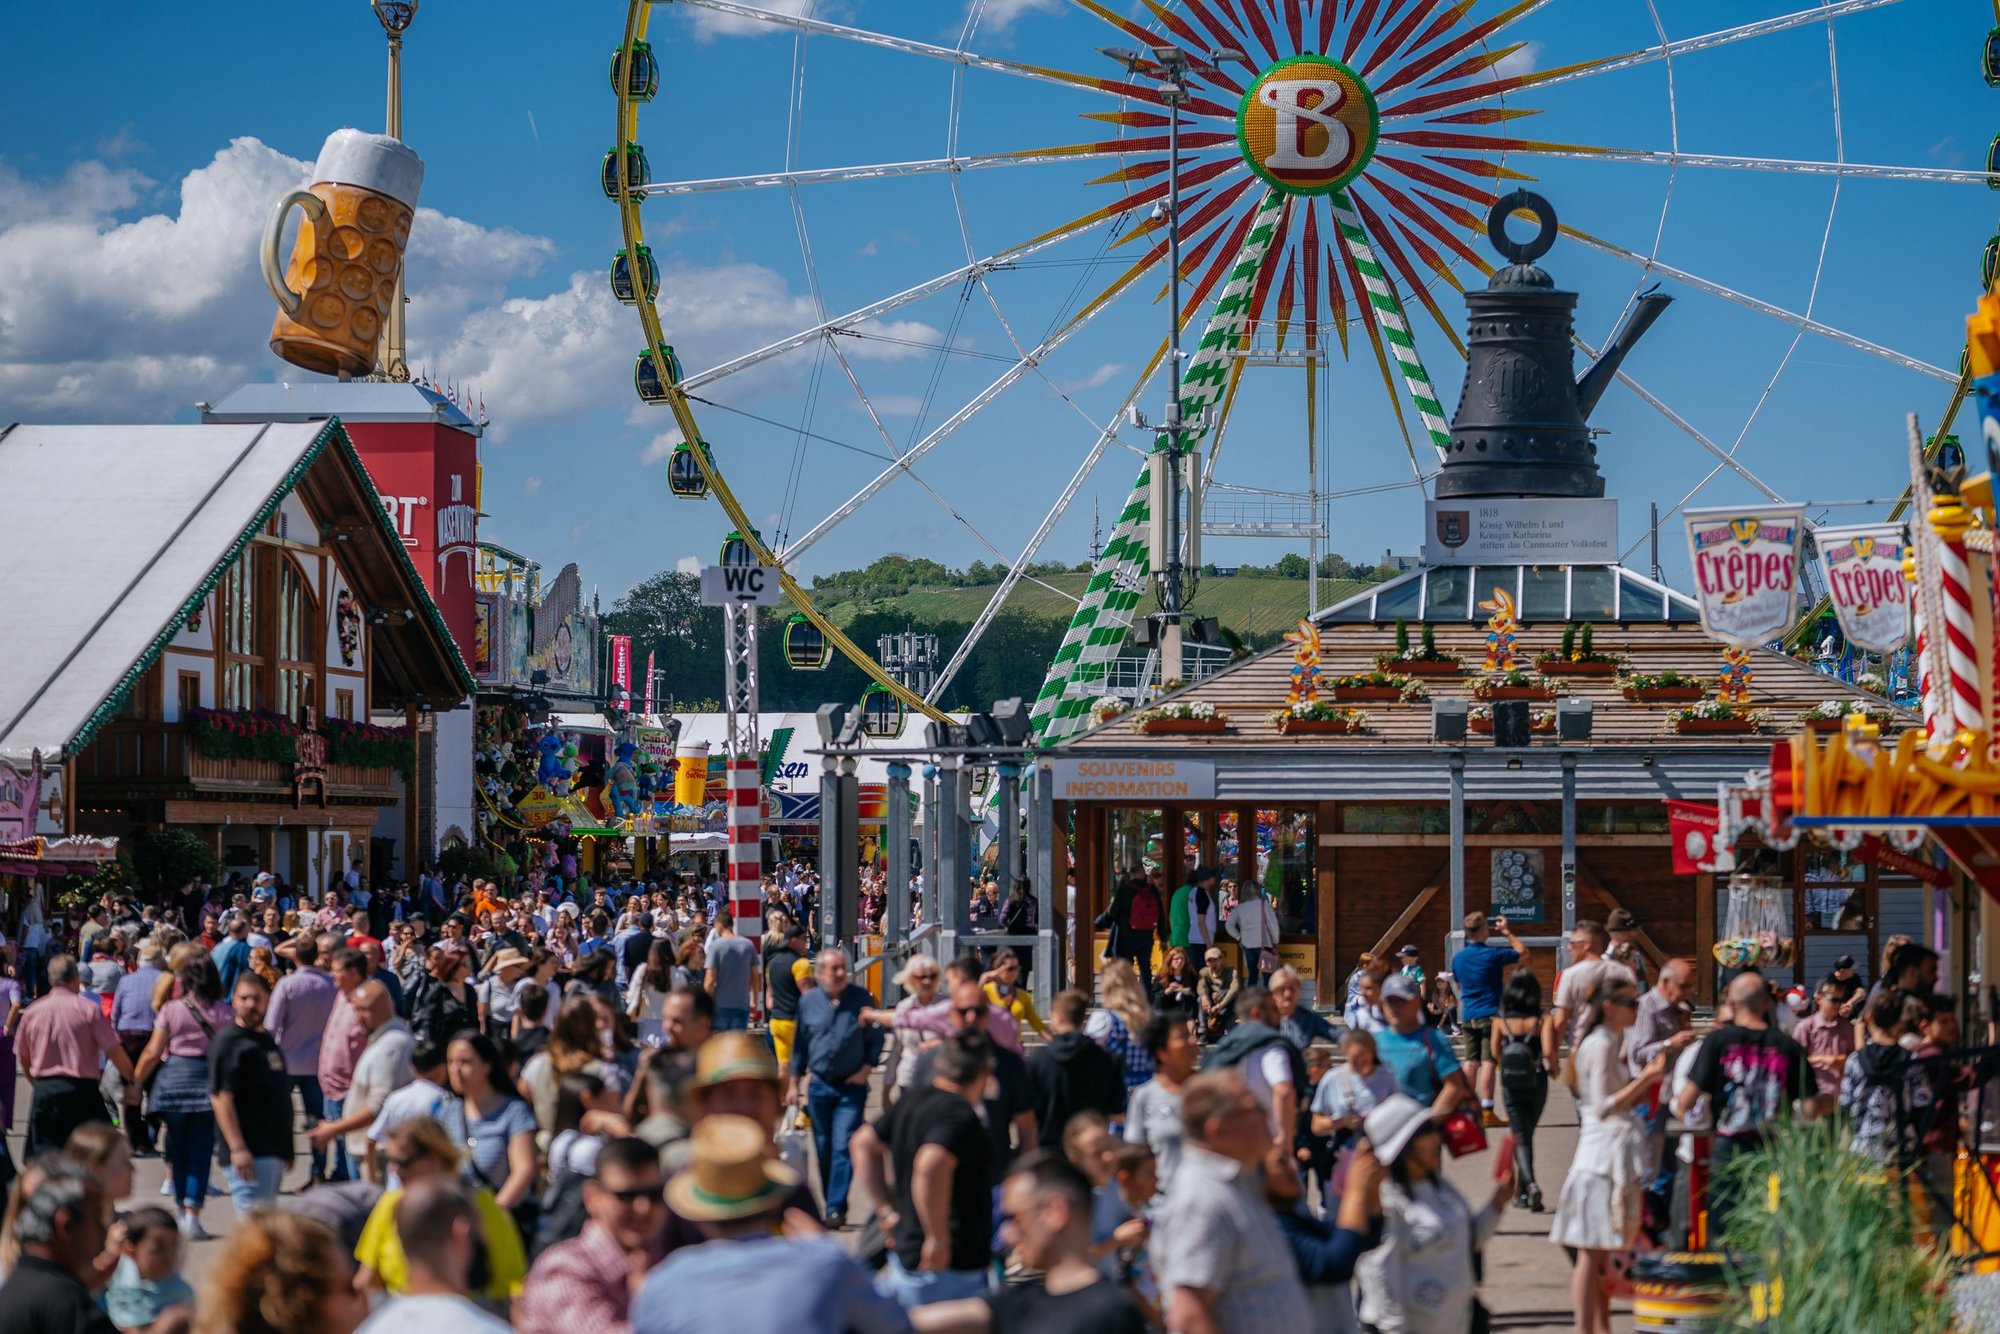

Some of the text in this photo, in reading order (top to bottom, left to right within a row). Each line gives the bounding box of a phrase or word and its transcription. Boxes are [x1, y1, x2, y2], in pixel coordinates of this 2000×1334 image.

[1259, 79, 1350, 170] B
[1479, 508, 1499, 518] 1818
[1479, 520, 1503, 530] König
[1505, 520, 1539, 529] Wilhelm
[1549, 520, 1564, 529] und
[1479, 530, 1552, 541] Königin Katharina
[1479, 540, 1608, 549] stiften das Cannstatter Volksfest
[1696, 546, 1795, 597] Crêpes
[724, 568, 764, 593] WC
[1829, 563, 1905, 608] Crêpes
[1077, 761, 1176, 778] SOUVENIRS
[1065, 780, 1189, 797] INFORMATION
